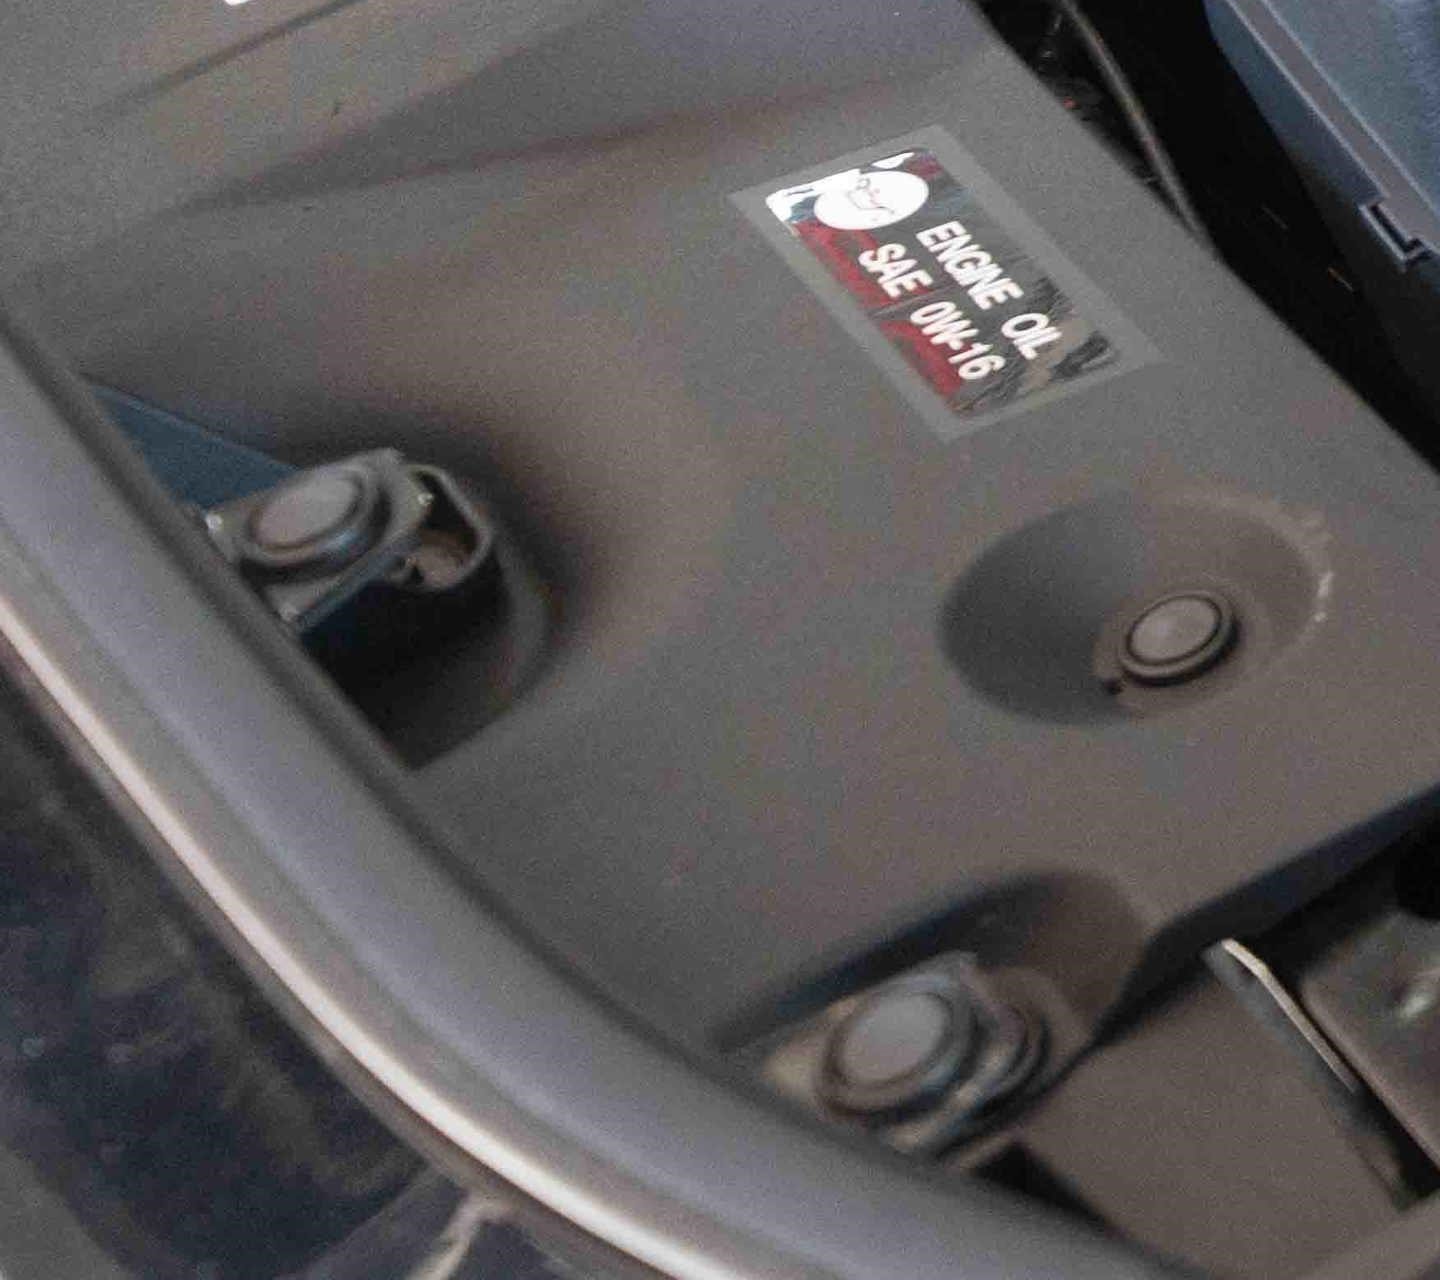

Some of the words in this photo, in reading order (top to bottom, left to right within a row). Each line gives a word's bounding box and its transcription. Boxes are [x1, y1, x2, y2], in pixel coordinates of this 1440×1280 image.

[858, 243, 935, 299] SAE
[910, 300, 1007, 381] 0W-16
[916, 220, 1024, 311] ENGINE
[1000, 312, 1064, 361] OIL
